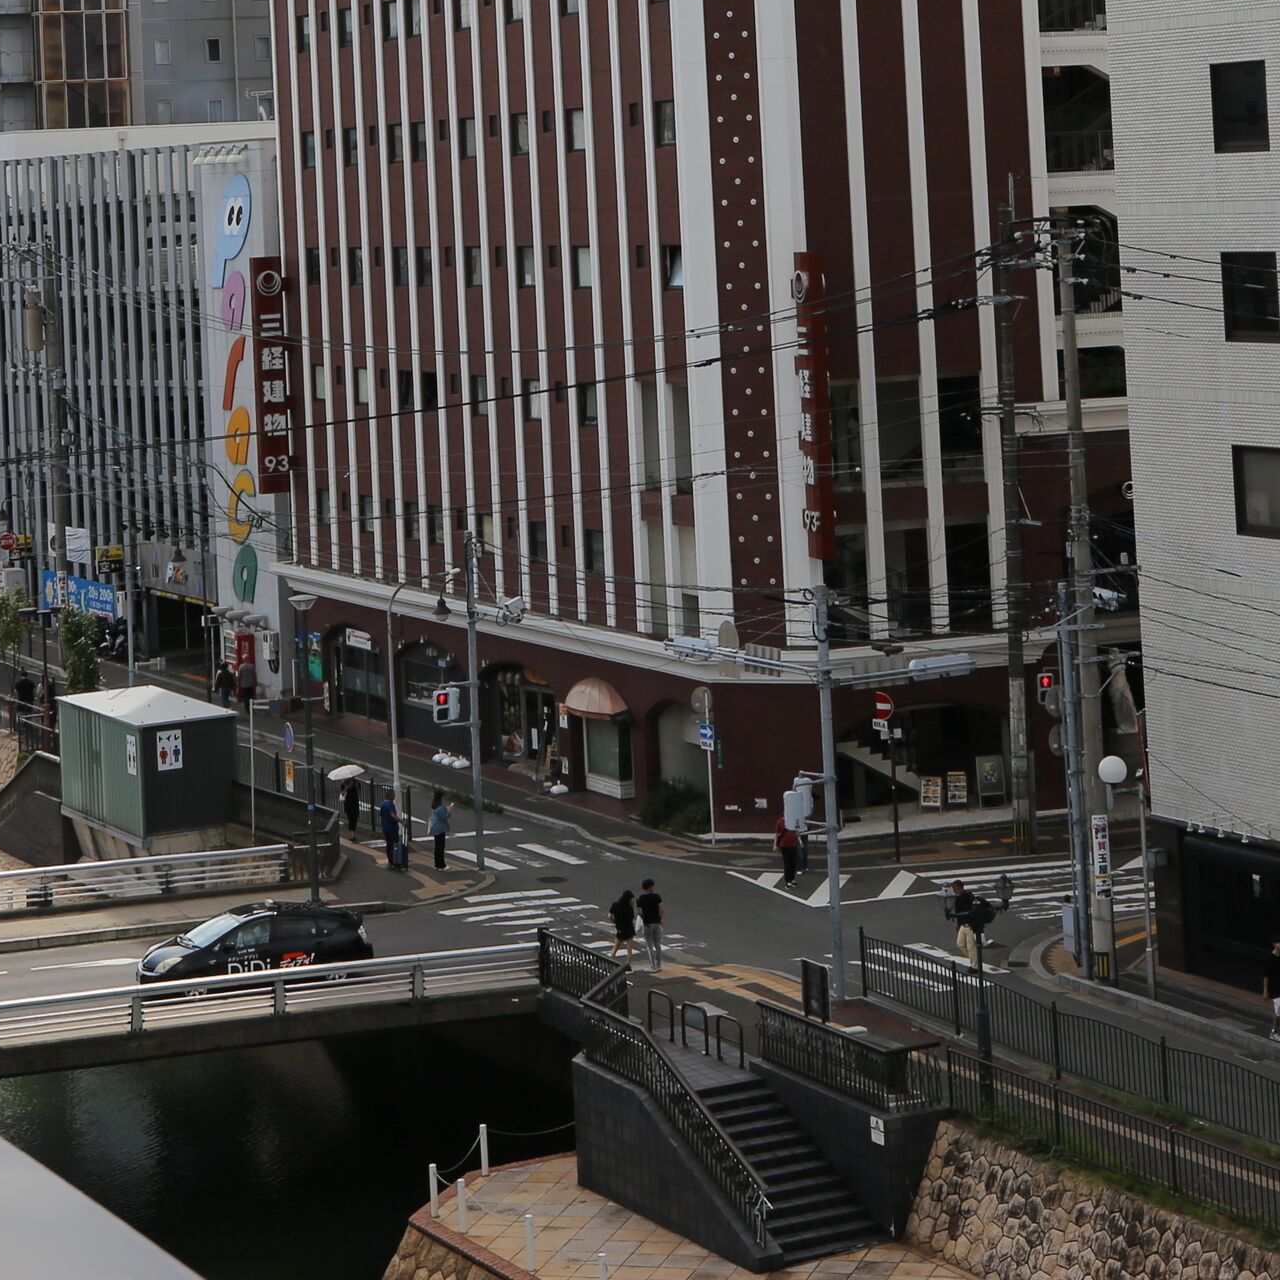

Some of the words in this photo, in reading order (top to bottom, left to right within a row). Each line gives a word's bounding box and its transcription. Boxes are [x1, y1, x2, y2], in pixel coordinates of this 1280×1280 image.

[260, 313, 287, 437] 三経建物
[264, 455, 290, 473] 93
[803, 510, 821, 532] 93
[158, 733, 180, 743] トイレ
[228, 957, 271, 975] DiDi
